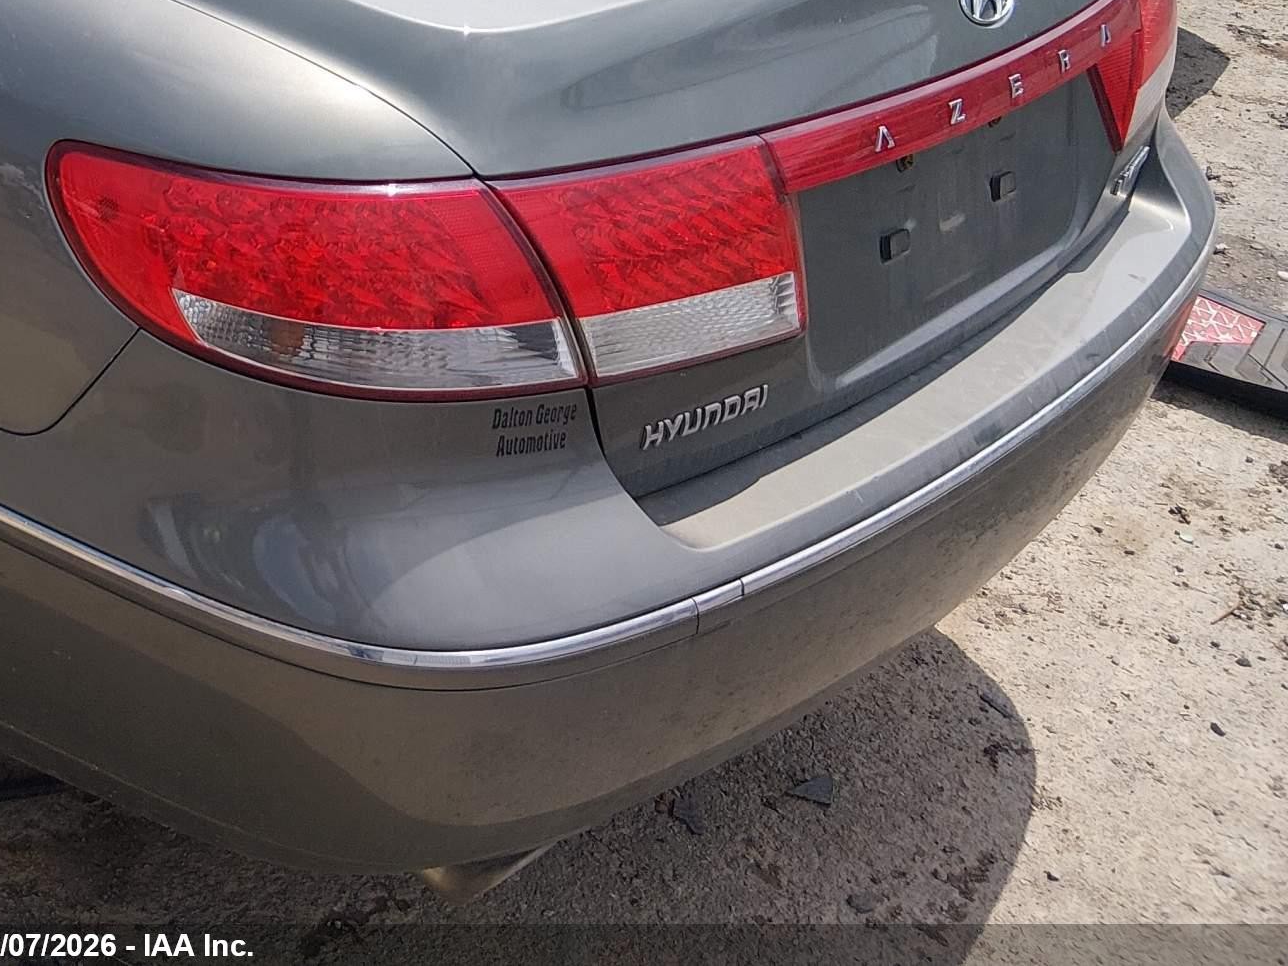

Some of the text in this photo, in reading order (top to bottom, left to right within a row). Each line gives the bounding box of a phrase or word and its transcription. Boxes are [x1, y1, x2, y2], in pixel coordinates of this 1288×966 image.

[874, 23, 1112, 153] AZERA
[492, 403, 577, 429] Dalton George
[641, 383, 769, 451] HYUNDAI
[495, 430, 567, 458] Automotive
